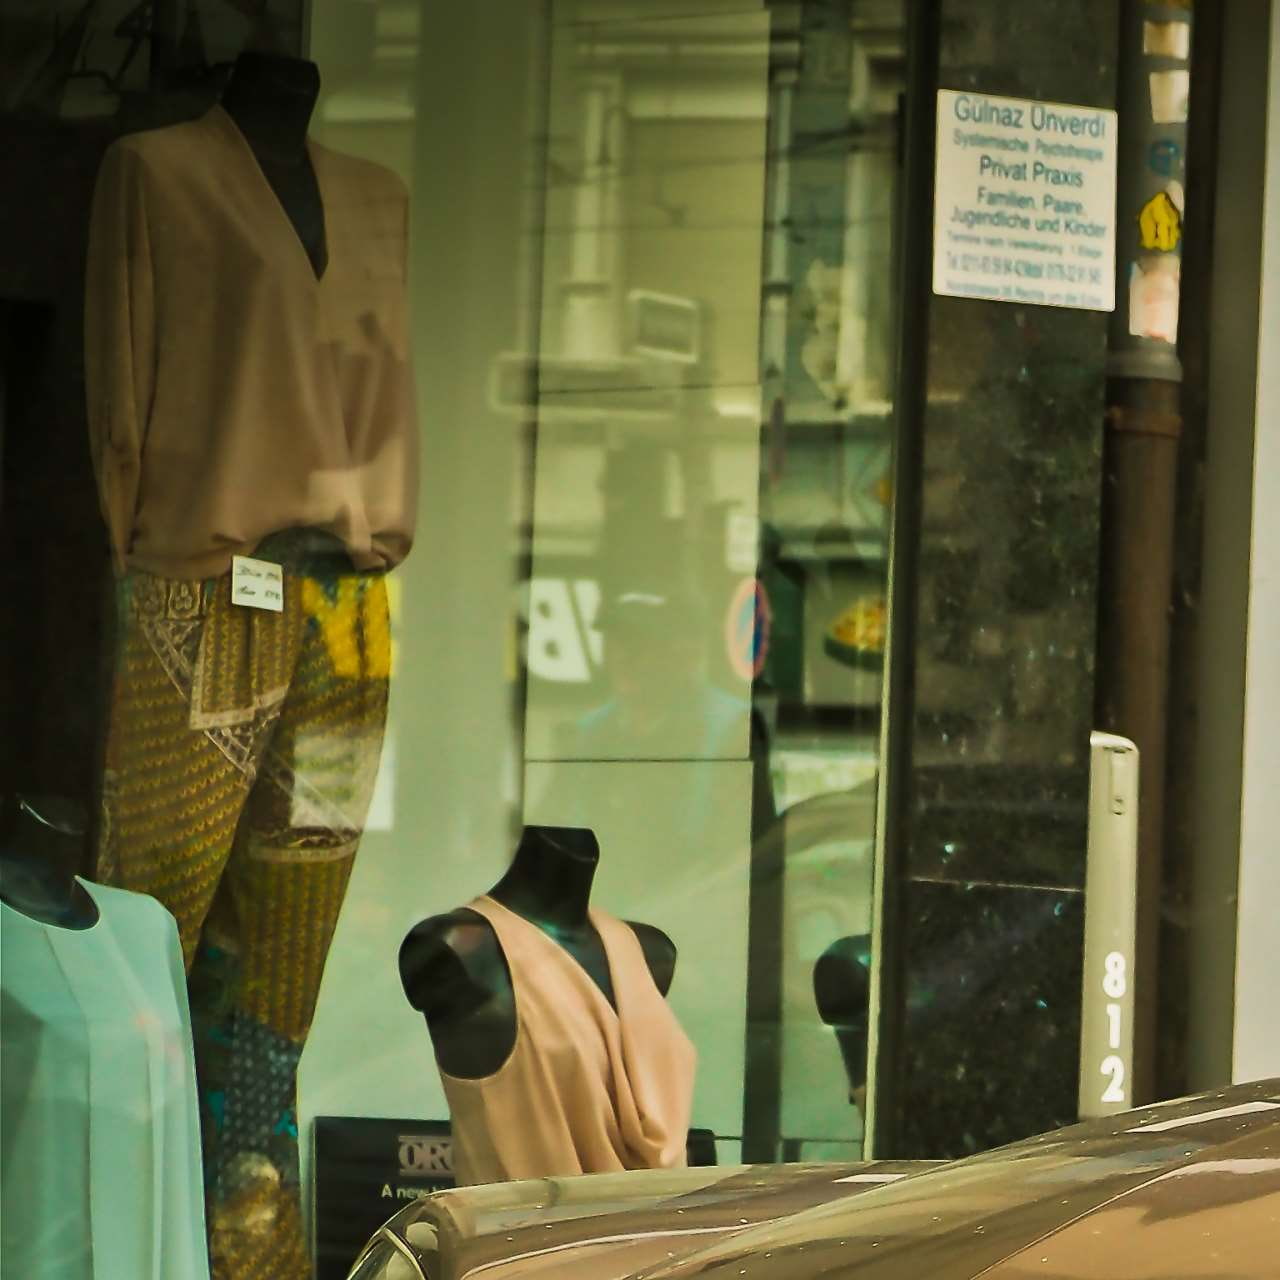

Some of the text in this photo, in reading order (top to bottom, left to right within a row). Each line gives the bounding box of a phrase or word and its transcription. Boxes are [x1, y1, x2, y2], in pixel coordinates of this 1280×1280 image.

[980, 155, 1083, 188] Privat Praxis
[1035, 218, 1060, 233] und
[1064, 219, 1106, 238] Kinder
